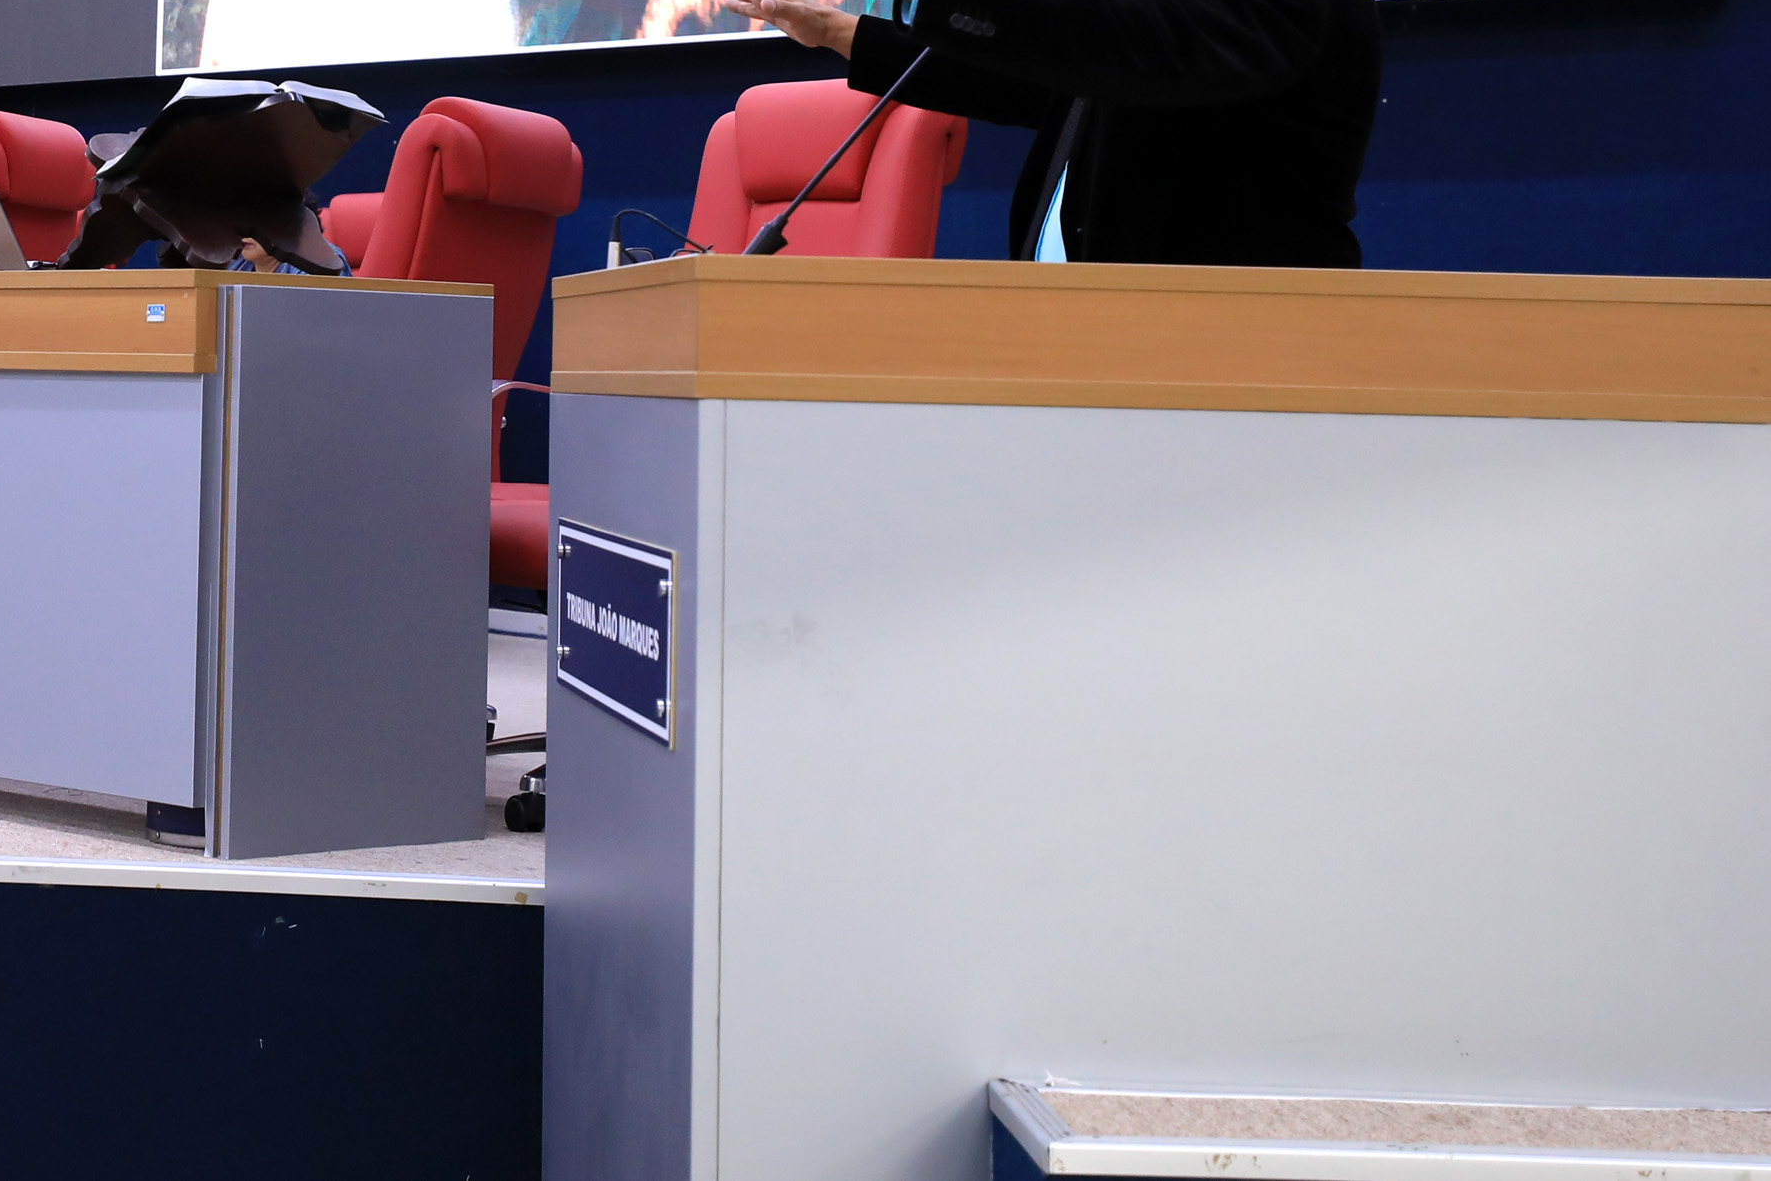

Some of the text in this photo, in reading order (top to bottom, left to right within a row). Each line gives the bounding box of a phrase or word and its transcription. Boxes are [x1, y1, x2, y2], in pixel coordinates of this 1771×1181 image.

[566, 591, 661, 662] TRIBUNA JOÃO MARQUES
